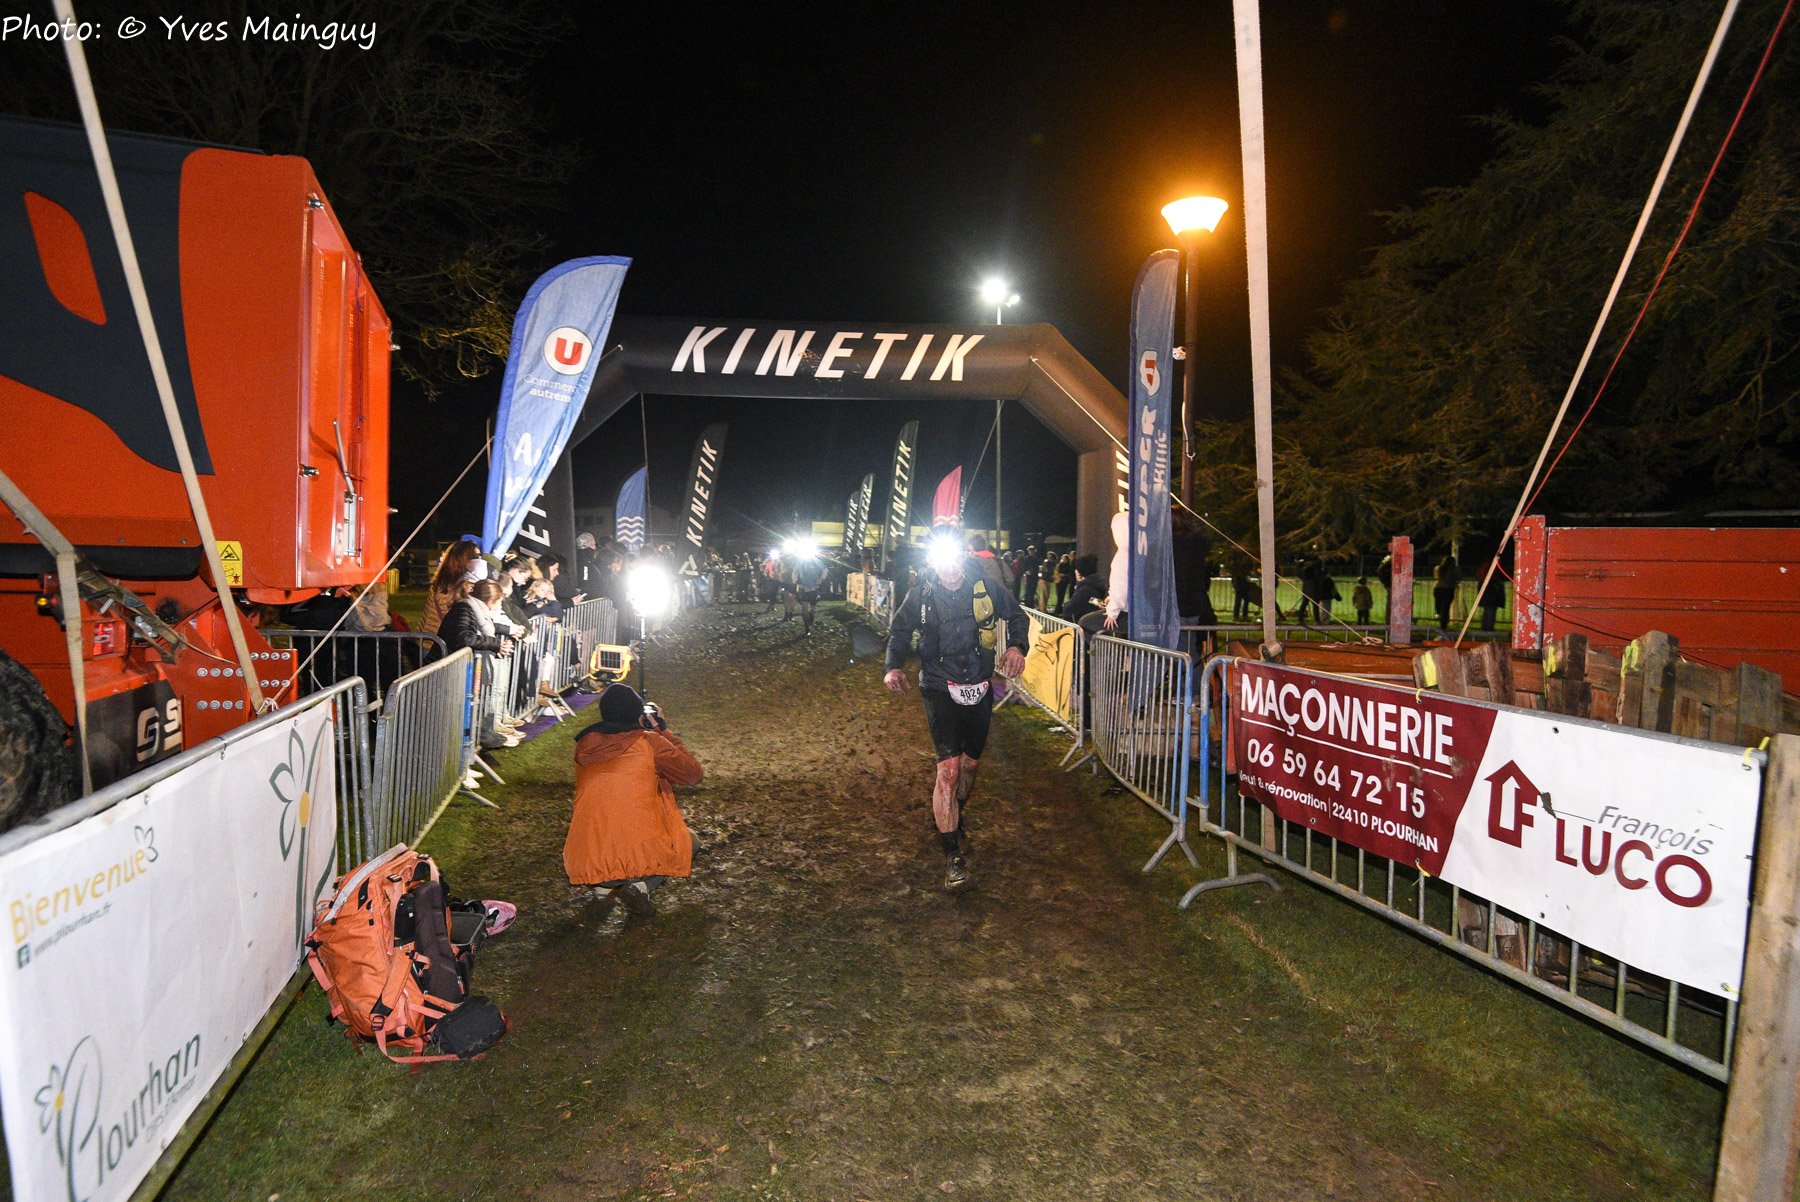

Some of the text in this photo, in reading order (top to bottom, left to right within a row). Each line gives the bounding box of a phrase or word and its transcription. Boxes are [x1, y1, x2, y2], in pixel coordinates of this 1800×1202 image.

[524, 374, 578, 393] Commer
[554, 337, 584, 366] U
[671, 326, 986, 381] KINETIK
[686, 438, 718, 548] KINETIK
[1137, 404, 1157, 557] SUPER
[959, 687, 982, 699] 4024
[1240, 673, 1454, 766] MAÇONNERIE
[1247, 738, 1426, 819] 06 59 64 72 15
[1265, 780, 1328, 813] rénovation
[1332, 802, 1368, 828] 22410
[1371, 815, 1439, 853] PLOURHAN
[1555, 817, 1713, 908] LUCO
[1597, 805, 1714, 856] François
[9, 848, 147, 945] Bienvenue
